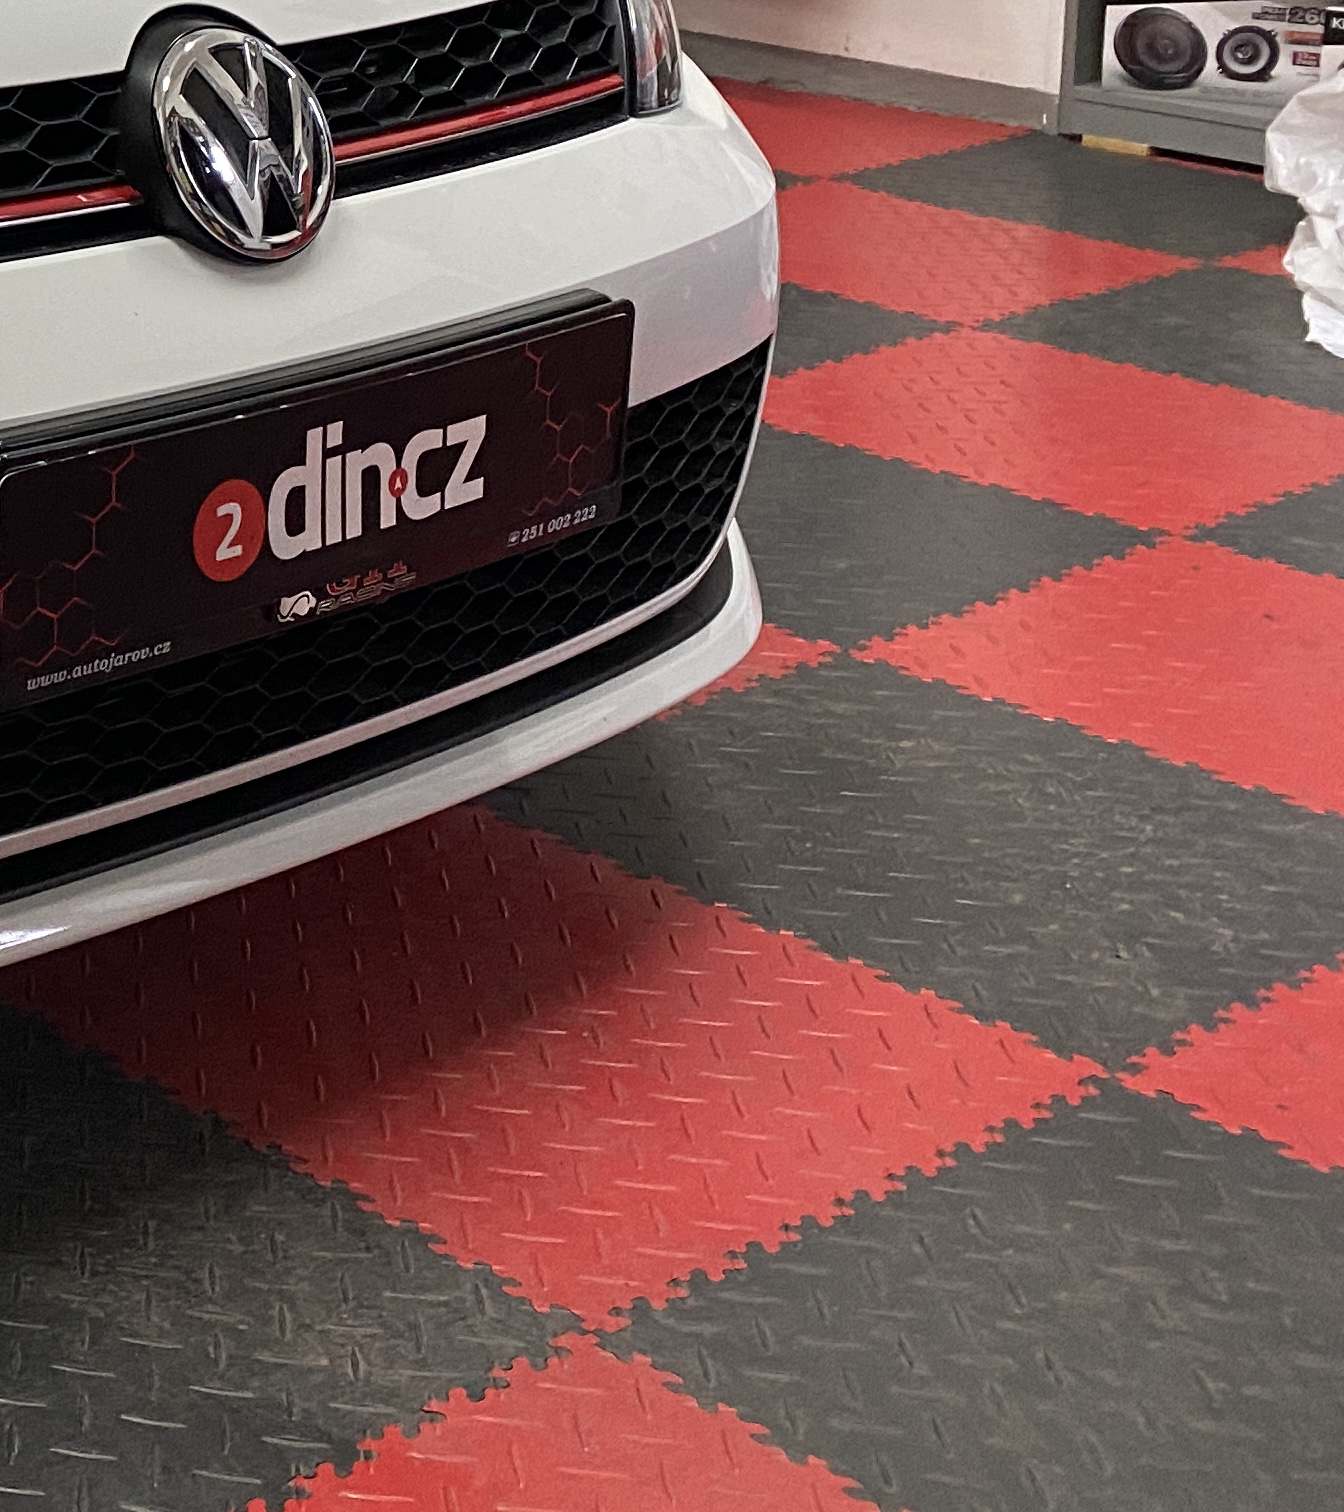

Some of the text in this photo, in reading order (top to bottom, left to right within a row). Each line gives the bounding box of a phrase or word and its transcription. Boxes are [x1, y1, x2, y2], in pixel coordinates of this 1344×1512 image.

[520, 504, 597, 543] 251 002 222
[26, 640, 172, 691] www.autojarov.cz
